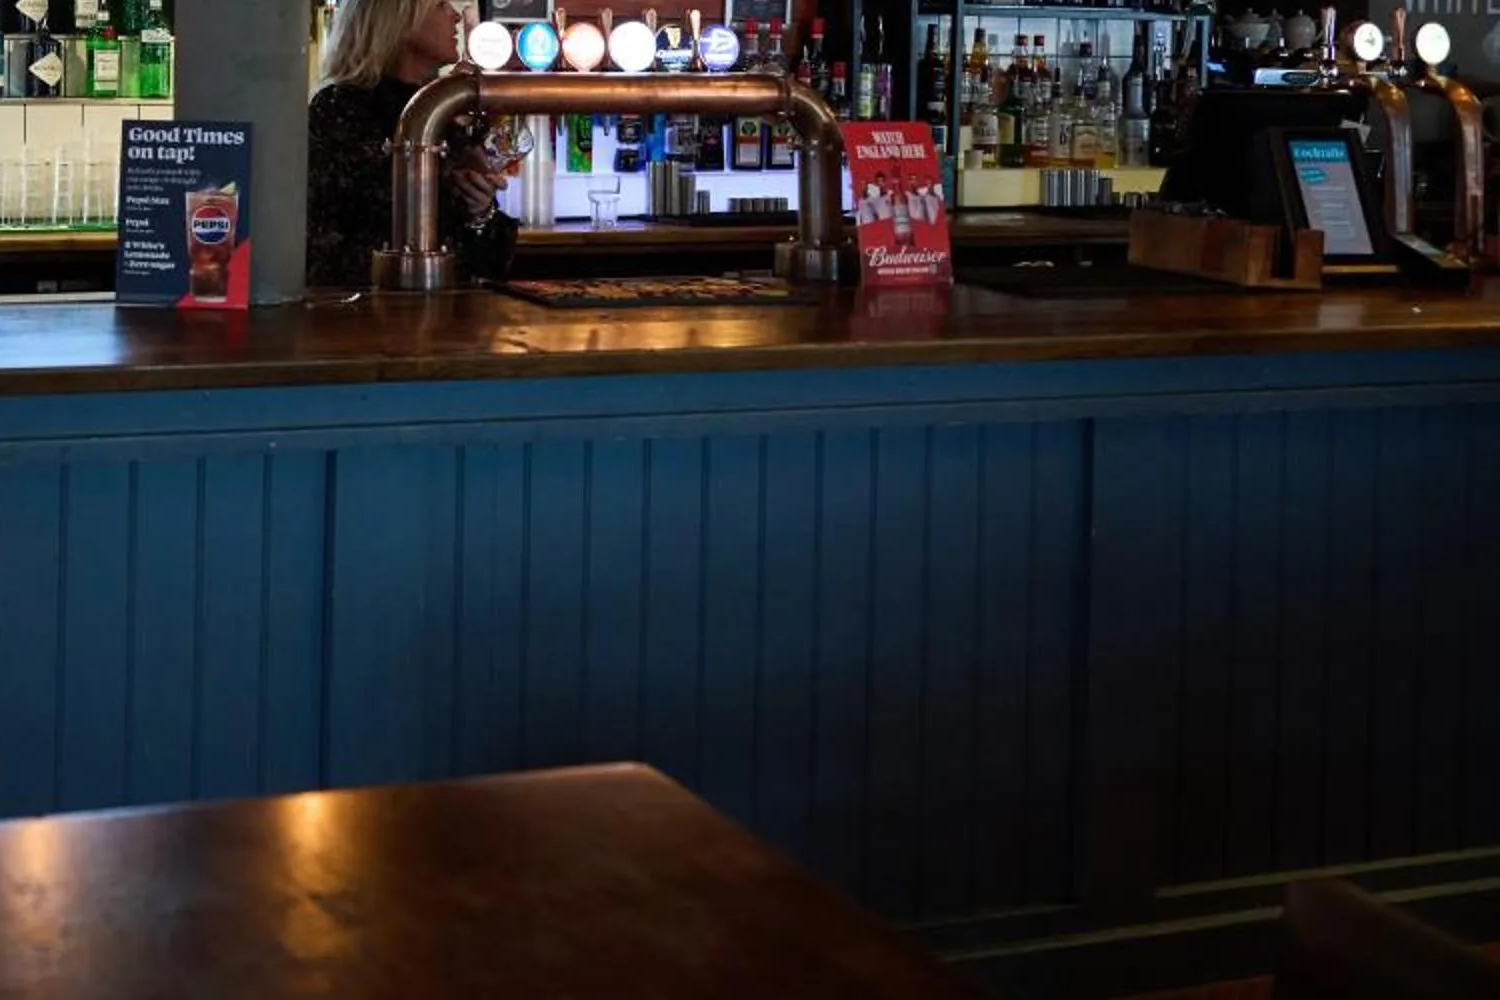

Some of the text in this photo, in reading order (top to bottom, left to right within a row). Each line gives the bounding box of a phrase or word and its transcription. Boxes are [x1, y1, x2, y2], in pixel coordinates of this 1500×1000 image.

[128, 127, 245, 144] Good Times
[128, 146, 196, 164] on tap!
[193, 220, 229, 229] PEPSI
[865, 245, 948, 267] Budweiser
